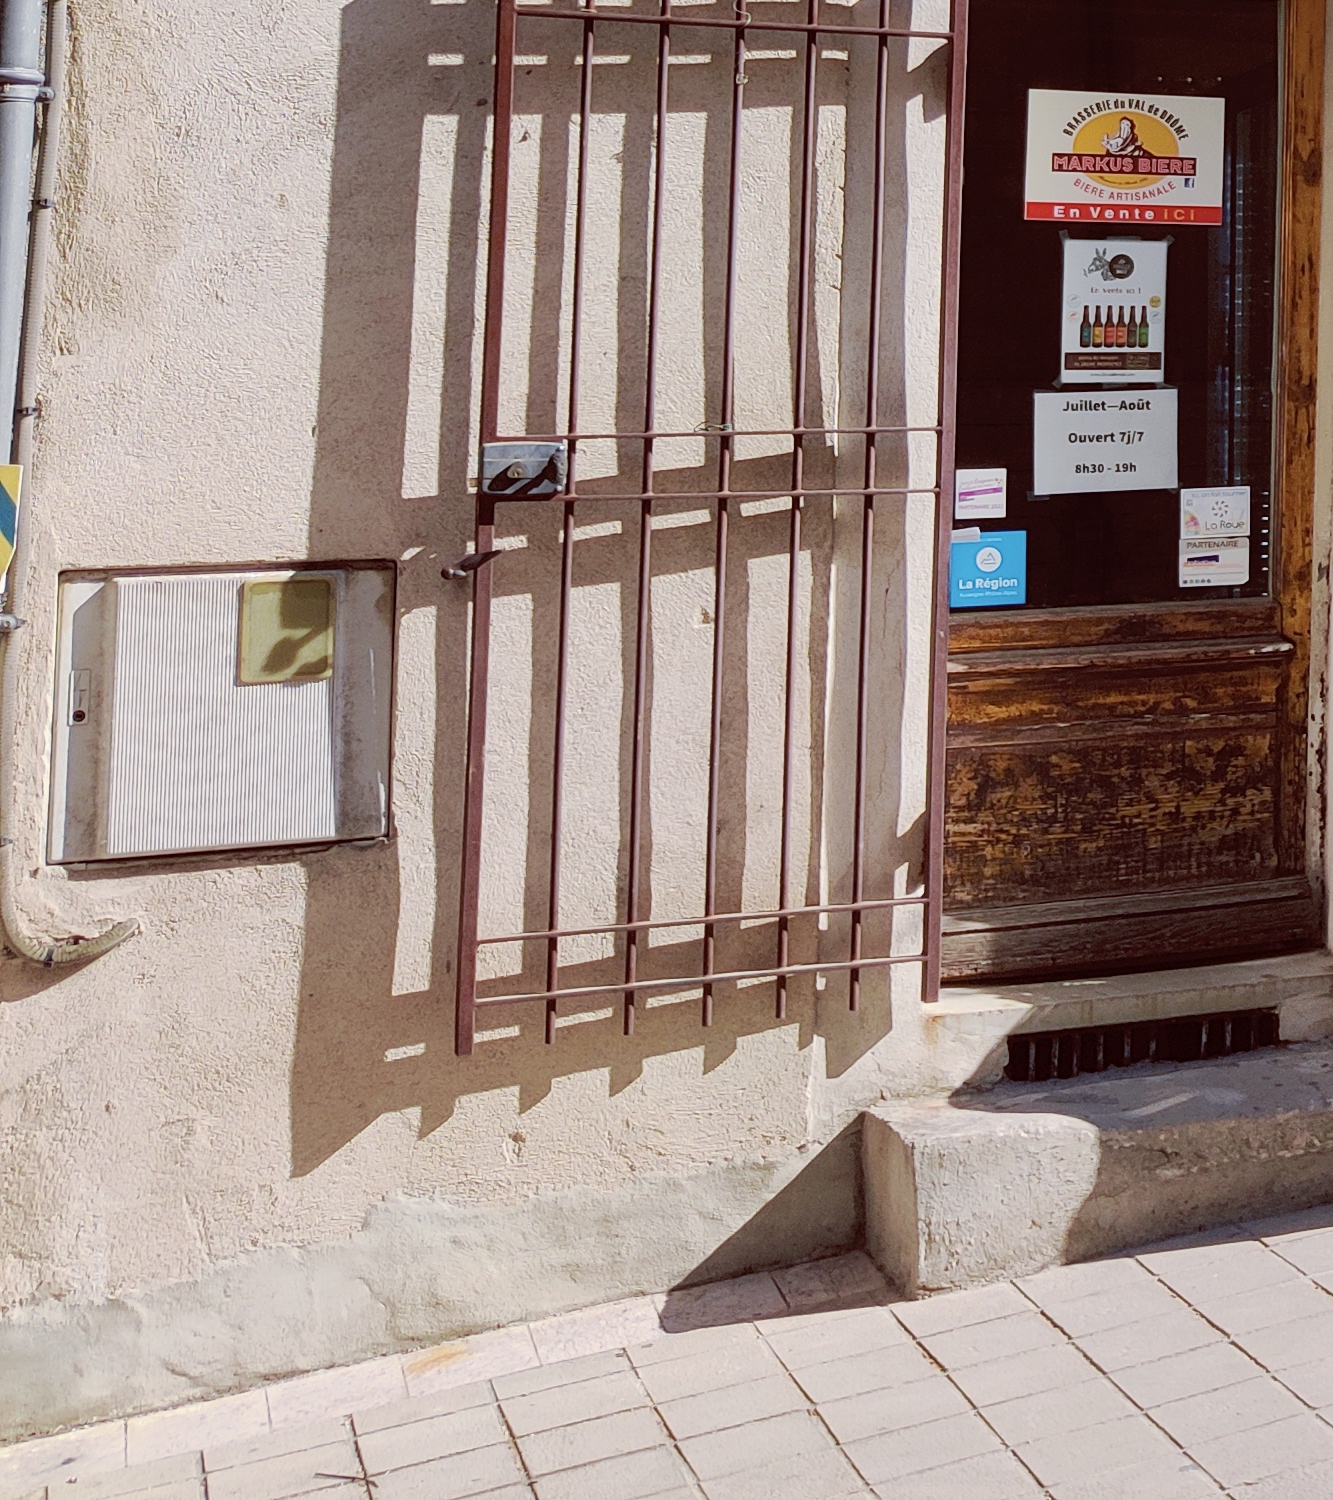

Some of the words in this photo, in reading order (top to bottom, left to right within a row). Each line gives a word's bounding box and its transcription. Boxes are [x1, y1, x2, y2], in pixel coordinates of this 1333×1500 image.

[1063, 99, 1113, 137] BRASSERIE
[1128, 98, 1146, 112] VAL
[1148, 103, 1159, 116] de
[1159, 109, 1190, 141] DRÔME
[1053, 156, 1134, 173] MARKUS
[1138, 158, 1195, 174] BIERE
[1073, 178, 1105, 199] BIERE
[1108, 181, 1177, 202] ARTISANALE
[1053, 205, 1080, 218] En
[1090, 206, 1155, 220] Vente
[1068, 432, 1116, 443] Ouvert
[1119, 430, 1145, 445] 7j/7
[1075, 463, 1104, 473] 8h30
[1115, 462, 1137, 473] 19h
[1205, 520, 1217, 530] La
[1220, 520, 1245, 529] Roue
[1187, 540, 1239, 549] PARTENAIRE
[959, 579, 973, 590] La
[975, 576, 1018, 591] Région
